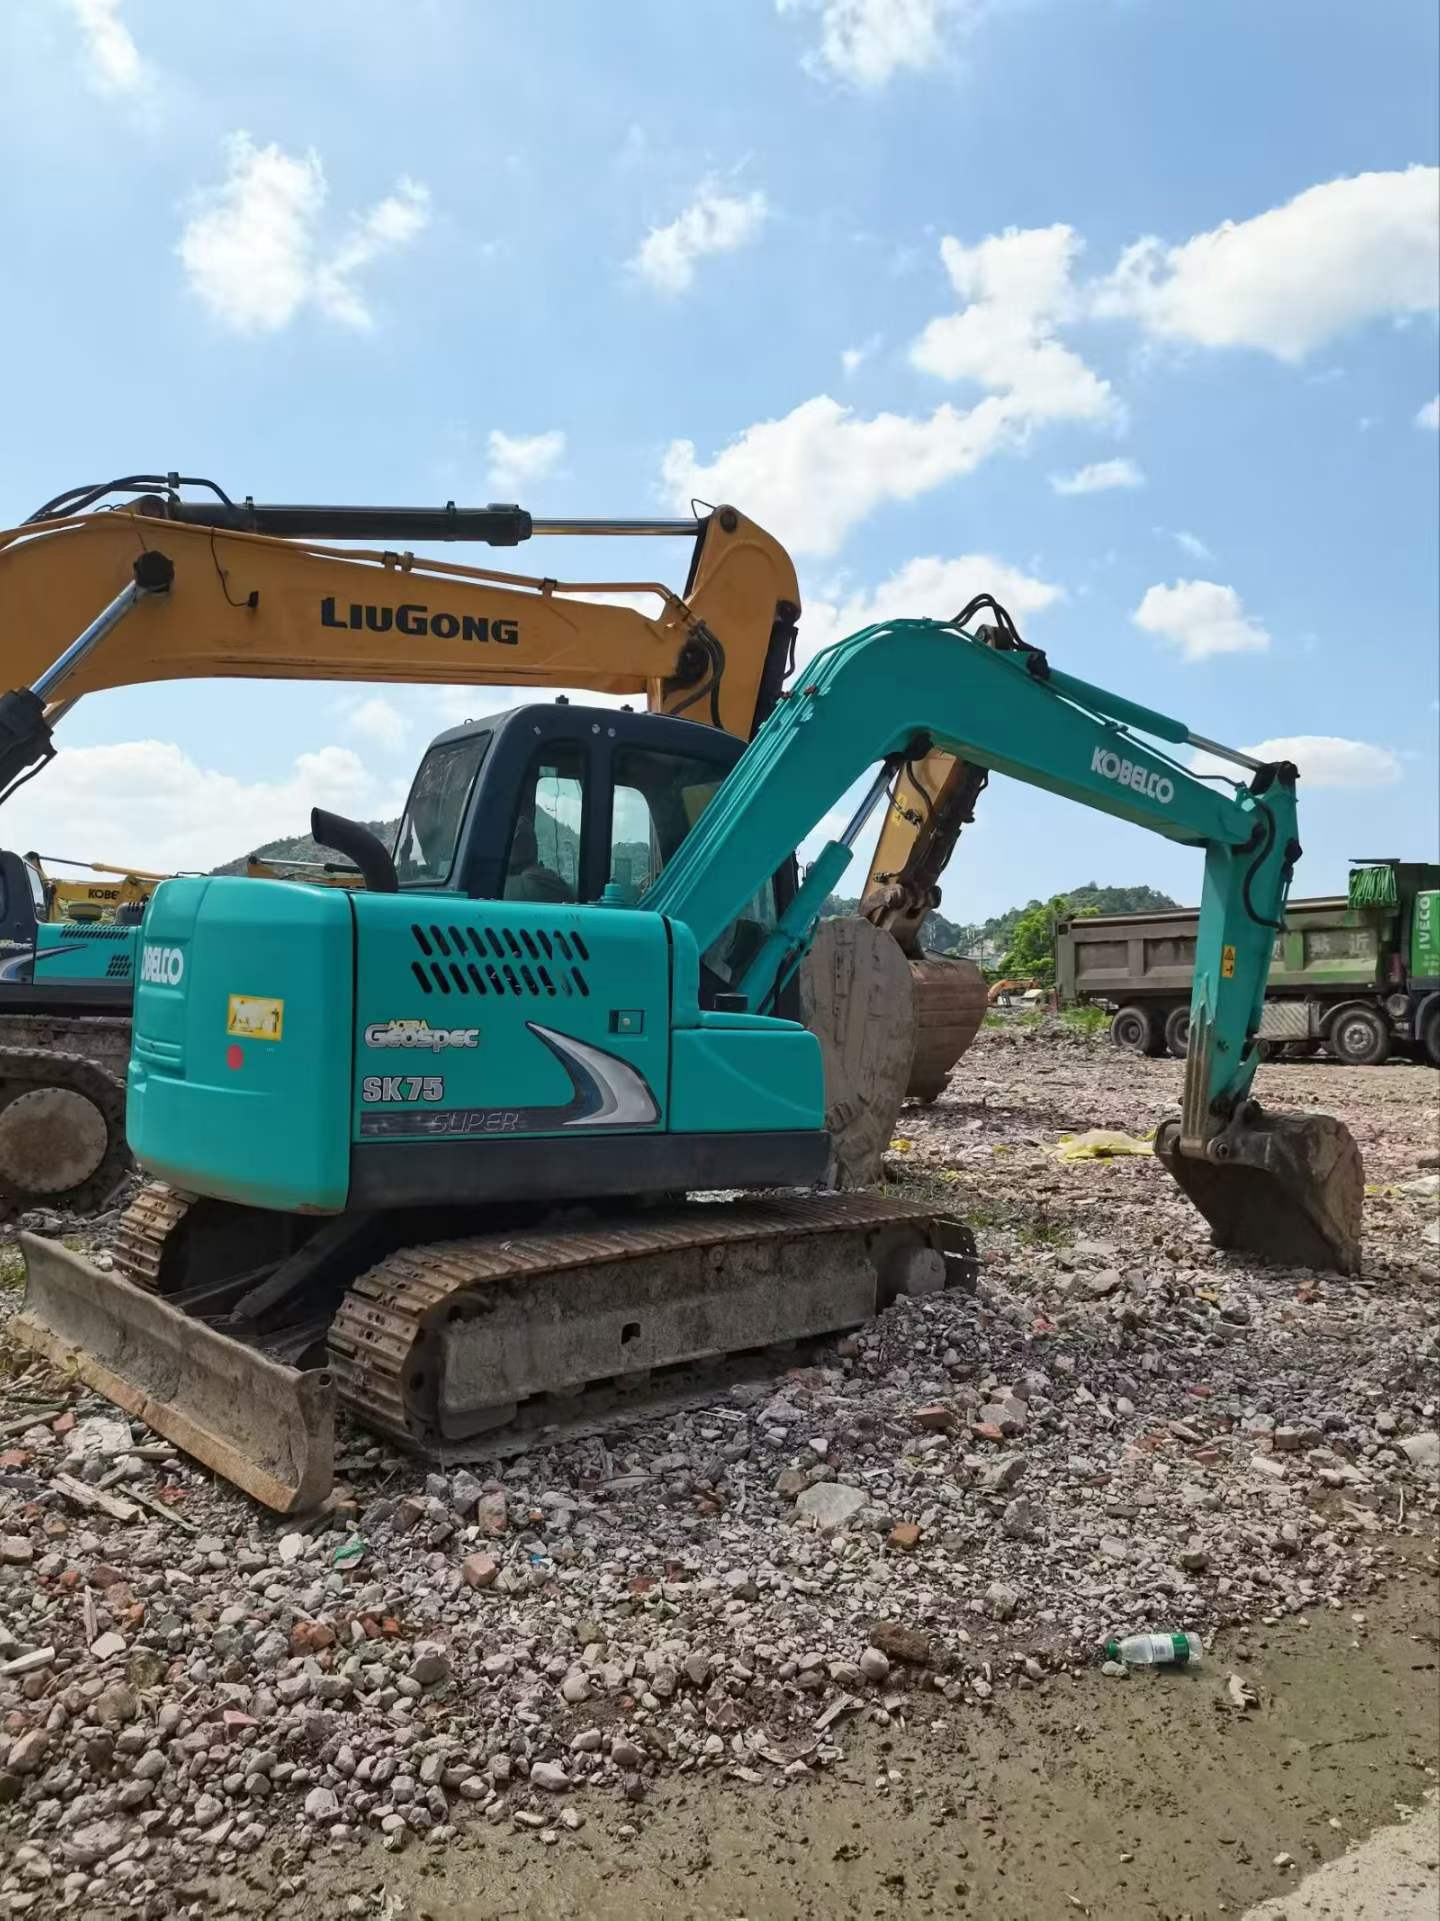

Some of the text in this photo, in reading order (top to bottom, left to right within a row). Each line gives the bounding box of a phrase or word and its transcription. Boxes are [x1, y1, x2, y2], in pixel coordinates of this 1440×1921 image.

[1091, 746, 1174, 804] KOBELCO
[1419, 896, 1431, 950] IVECO
[362, 1076, 443, 1102] SK75
[428, 1111, 519, 1134] SUPER
